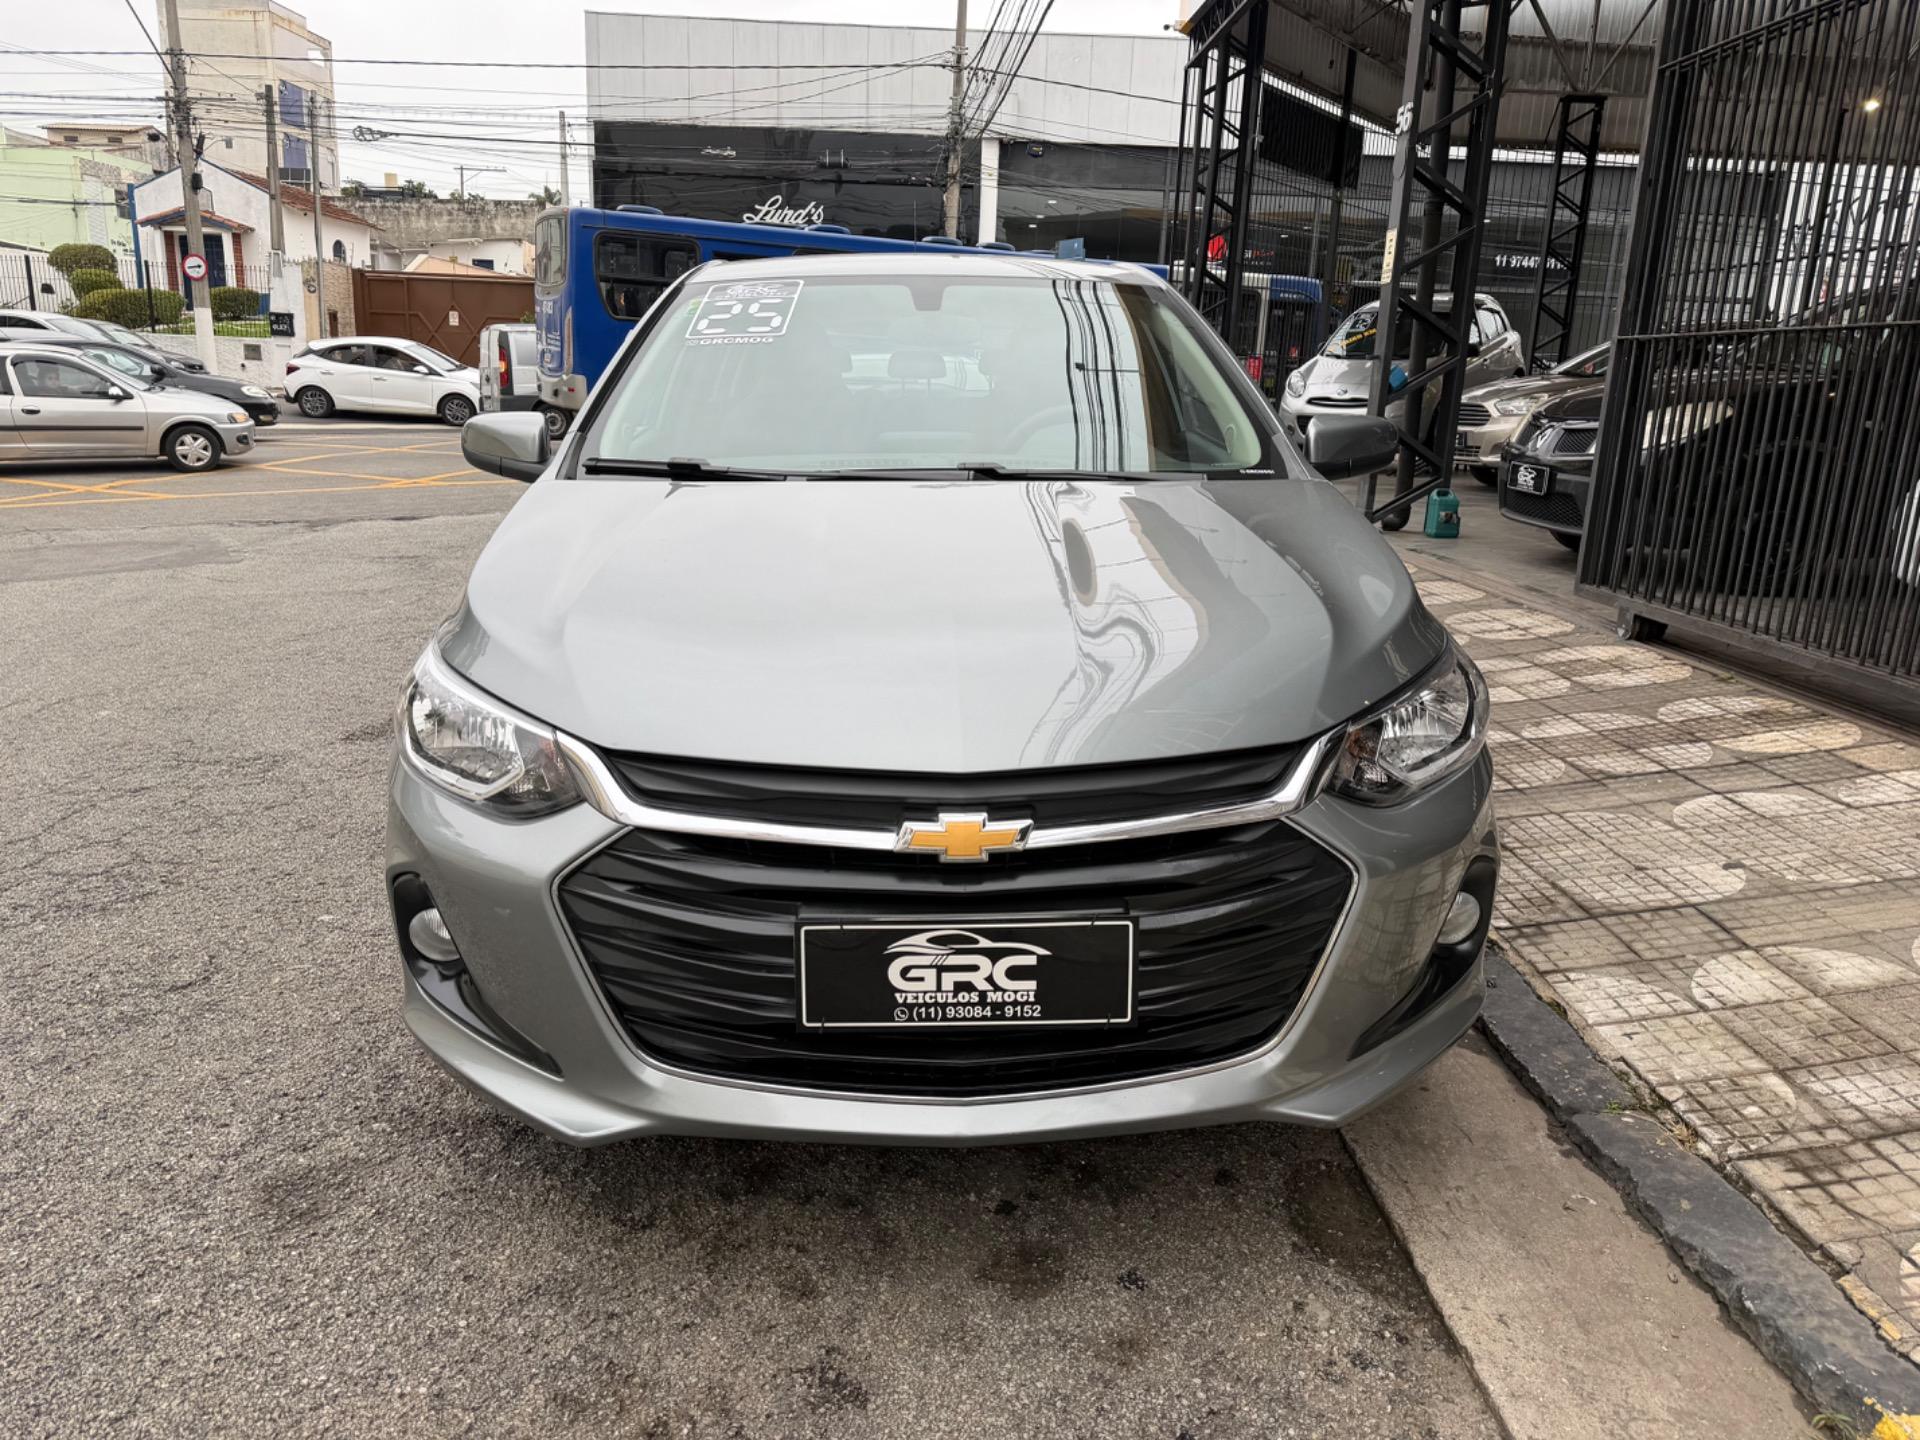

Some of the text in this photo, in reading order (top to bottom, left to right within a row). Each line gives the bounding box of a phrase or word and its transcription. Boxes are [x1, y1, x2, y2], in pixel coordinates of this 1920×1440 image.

[1395, 101, 1413, 135] 56
[743, 195, 824, 224] Lund's
[1495, 254, 1507, 268] 11
[697, 299, 783, 334] 25
[887, 954, 1038, 992] GRC
[894, 991, 1036, 1004] VEICULOS MOGI
[912, 1006, 942, 1021] (11)
[945, 1005, 992, 1019] 93084
[1004, 1004, 1042, 1018] 9152
